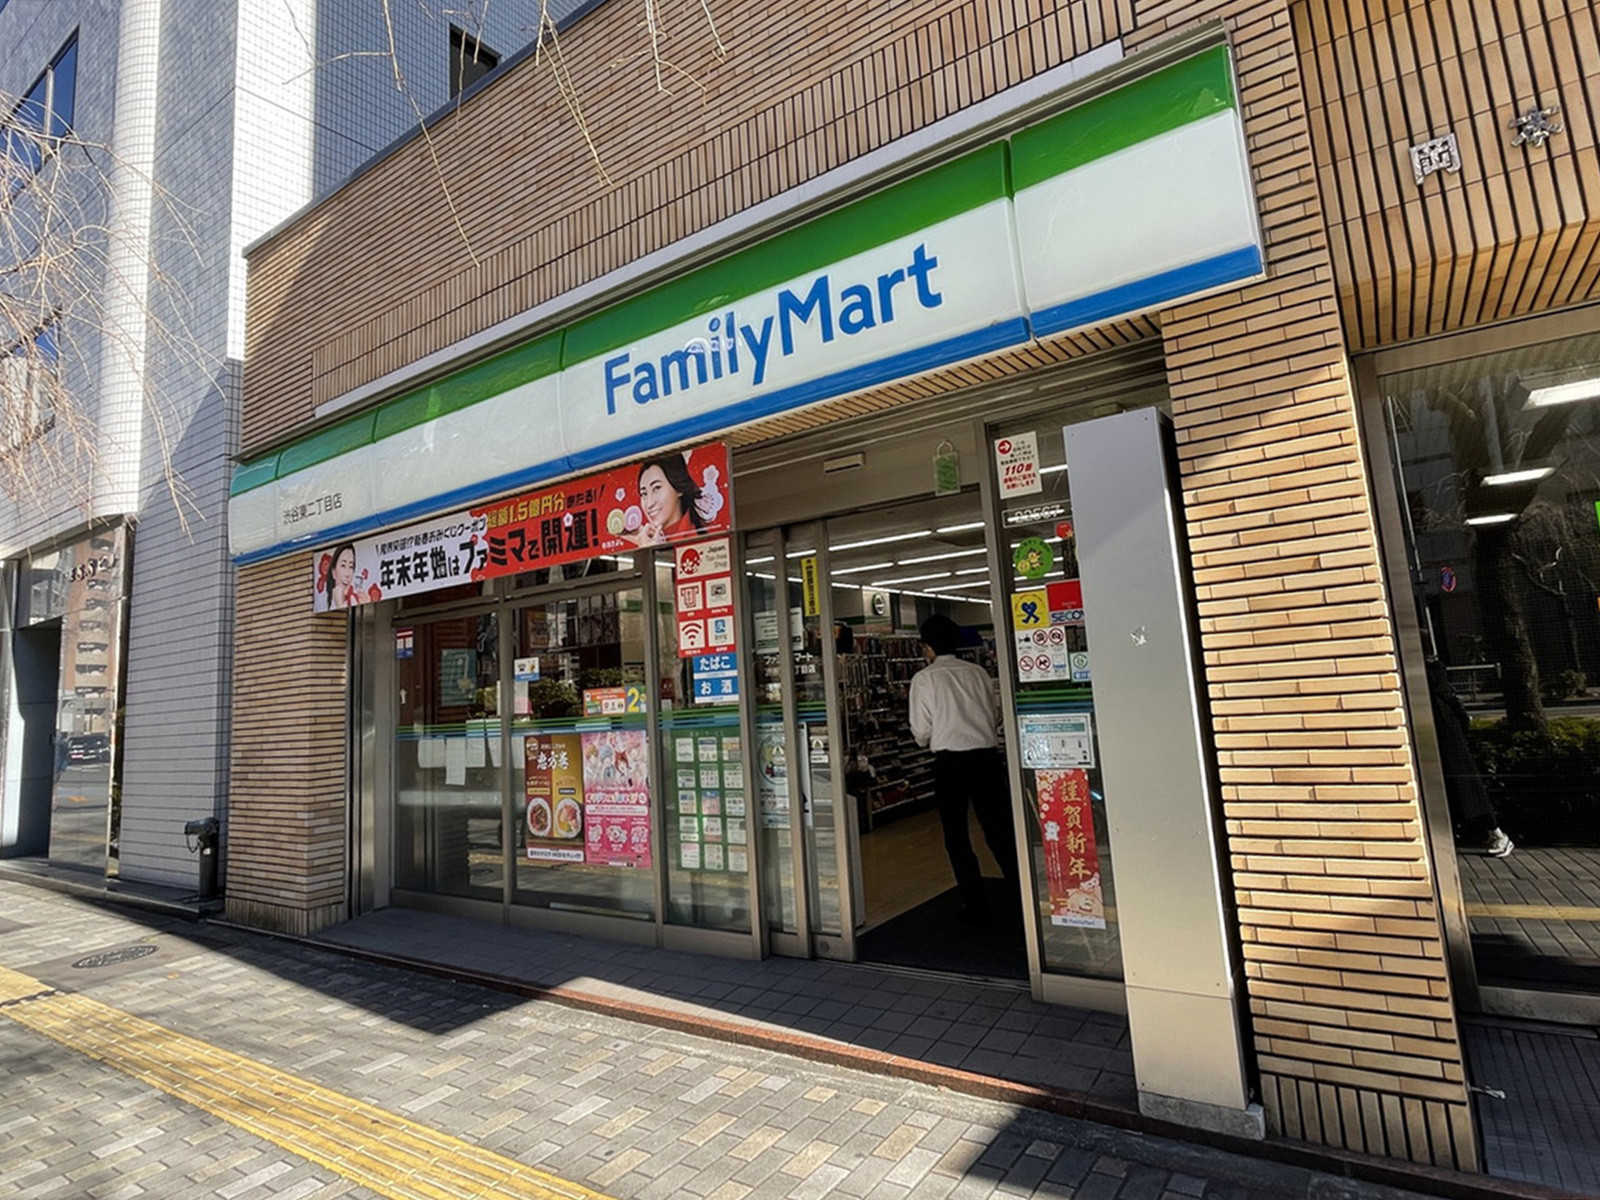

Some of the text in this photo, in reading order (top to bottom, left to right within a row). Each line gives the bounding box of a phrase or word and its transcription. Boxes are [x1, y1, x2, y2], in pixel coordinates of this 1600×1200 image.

[604, 243, 943, 415] FamilyMart
[283, 493, 342, 525] 渋谷東二丁目店
[1014, 504, 1061, 524] 22567
[380, 508, 599, 590] 年末年始はファミマで開運!
[699, 656, 732, 671] たばこ
[700, 679, 733, 695] お酒
[537, 751, 569, 770] 恵方巻
[1058, 780, 1093, 880] 謹賀新年
